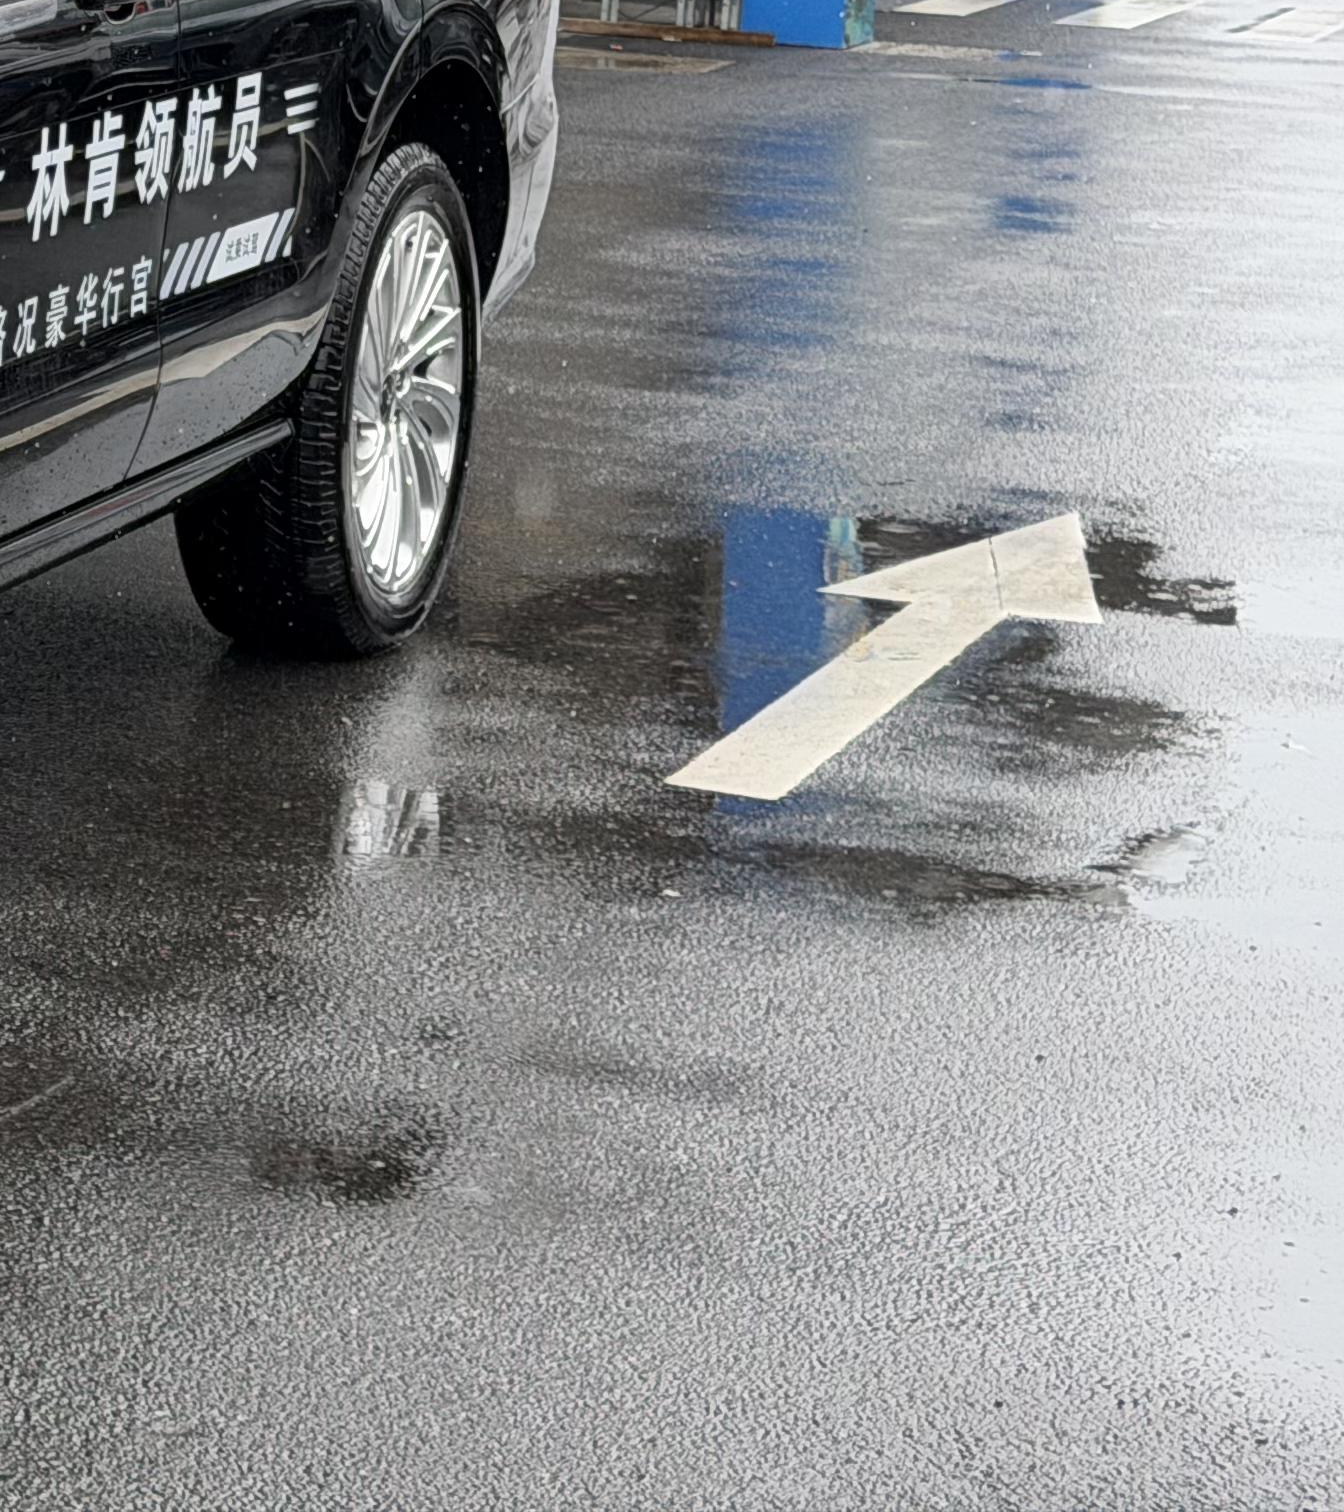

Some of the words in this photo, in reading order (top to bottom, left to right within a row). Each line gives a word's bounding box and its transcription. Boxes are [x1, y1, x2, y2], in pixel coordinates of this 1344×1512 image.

[26, 71, 263, 242] 林肯领航员
